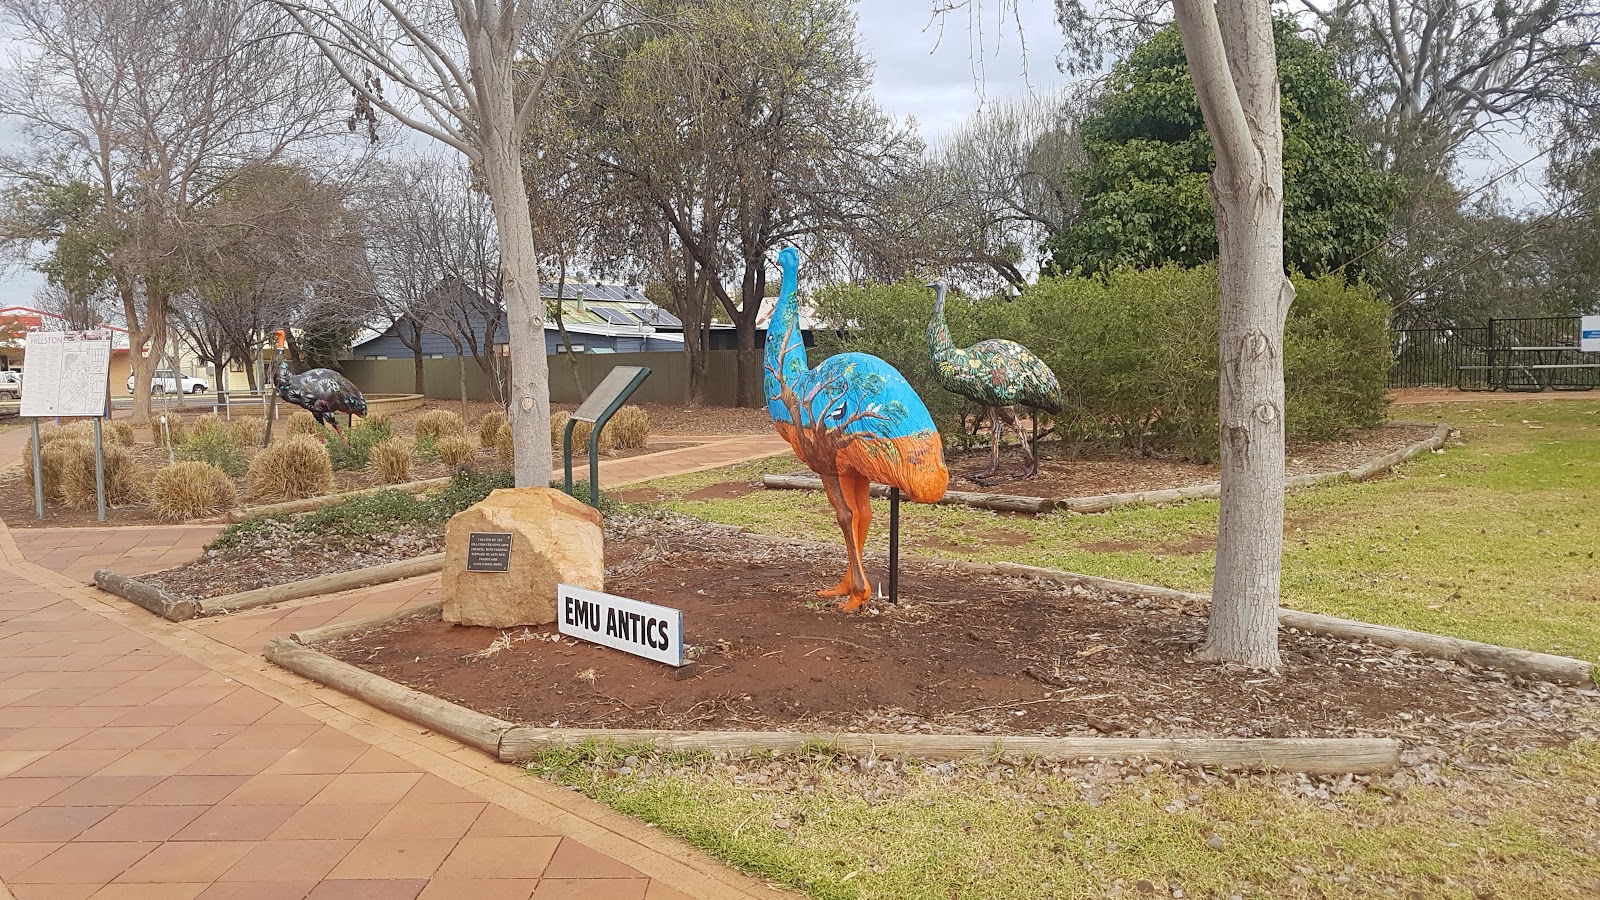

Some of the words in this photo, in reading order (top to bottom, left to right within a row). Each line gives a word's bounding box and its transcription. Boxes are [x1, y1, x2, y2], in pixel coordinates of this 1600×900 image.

[30, 336, 63, 345] HILLSTON
[565, 596, 600, 632] EMU
[606, 607, 669, 651] ANTICS
